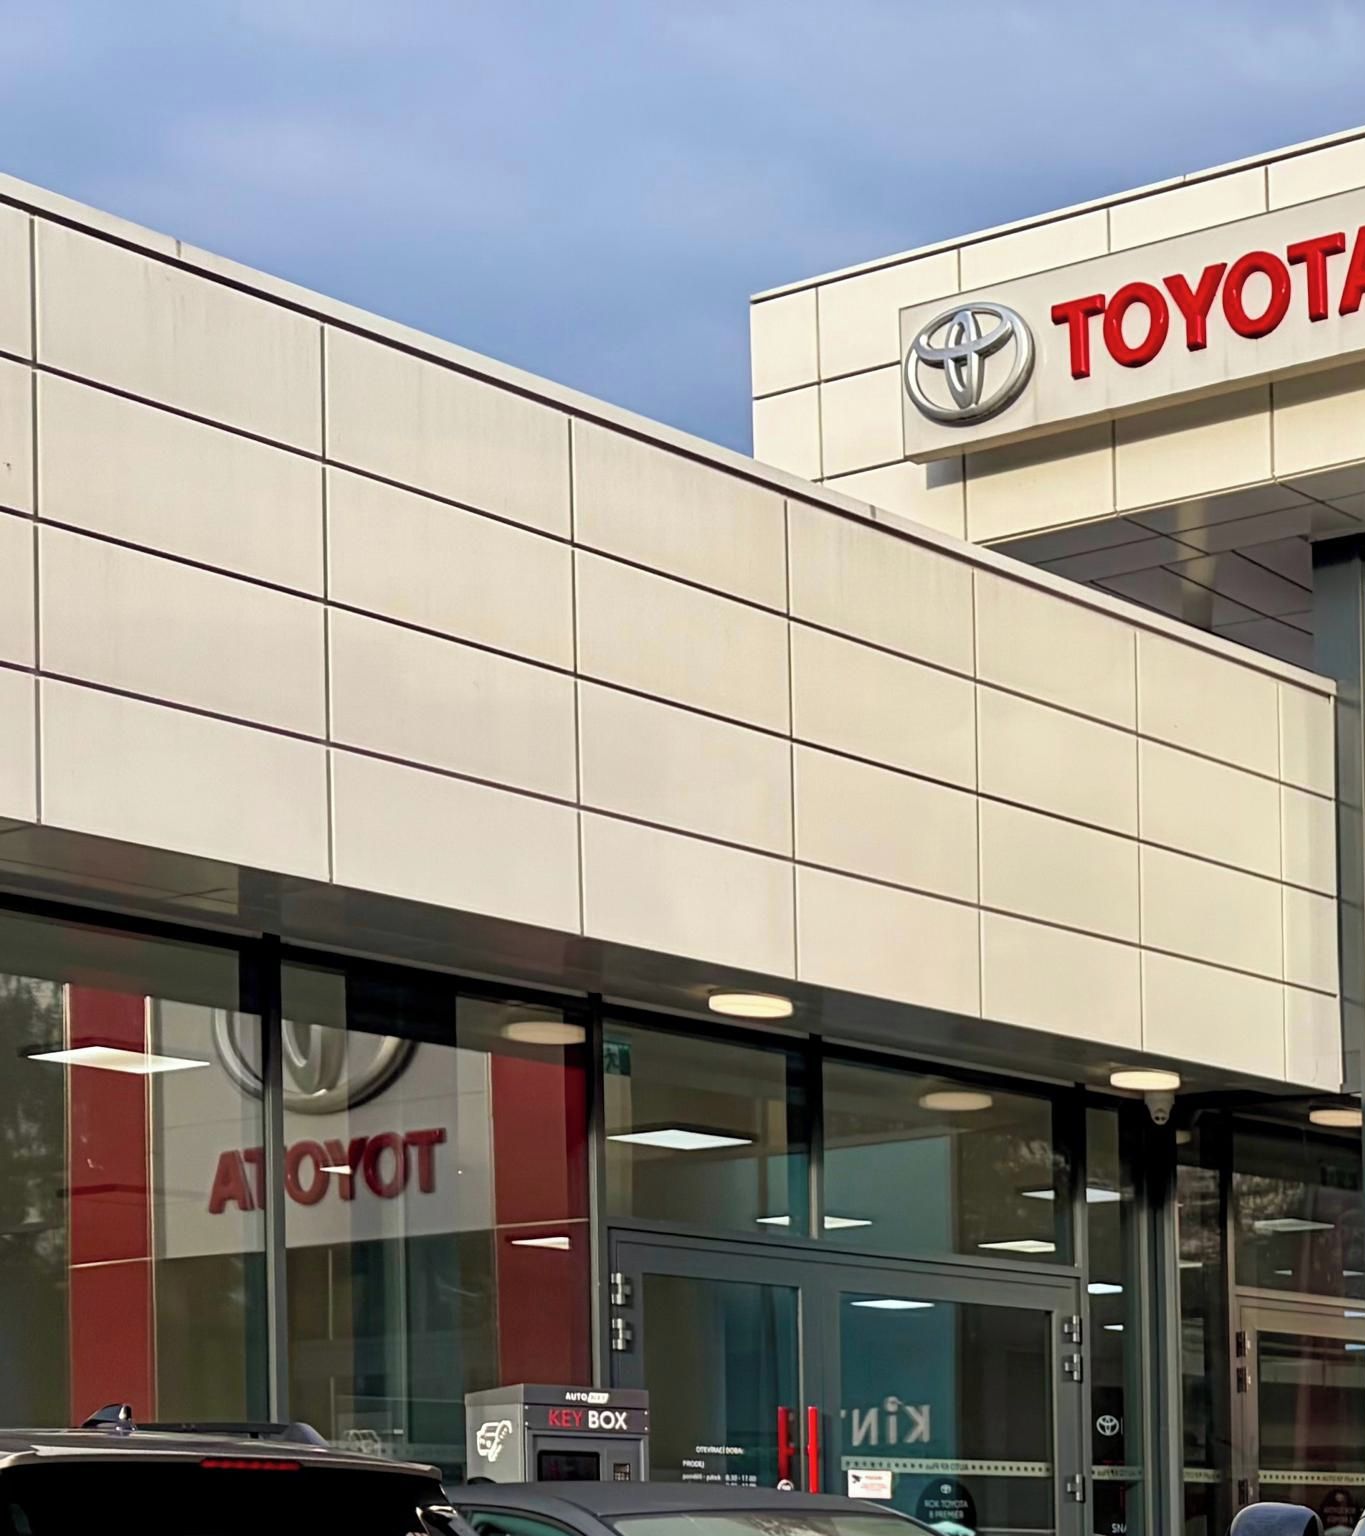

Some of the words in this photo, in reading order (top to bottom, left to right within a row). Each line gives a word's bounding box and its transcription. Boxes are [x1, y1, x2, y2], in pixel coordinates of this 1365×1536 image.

[565, 1392, 587, 1401] AUTO
[548, 1409, 583, 1427] KEY
[588, 1410, 627, 1430] BOX
[941, 1500, 968, 1508] TOYOTA
